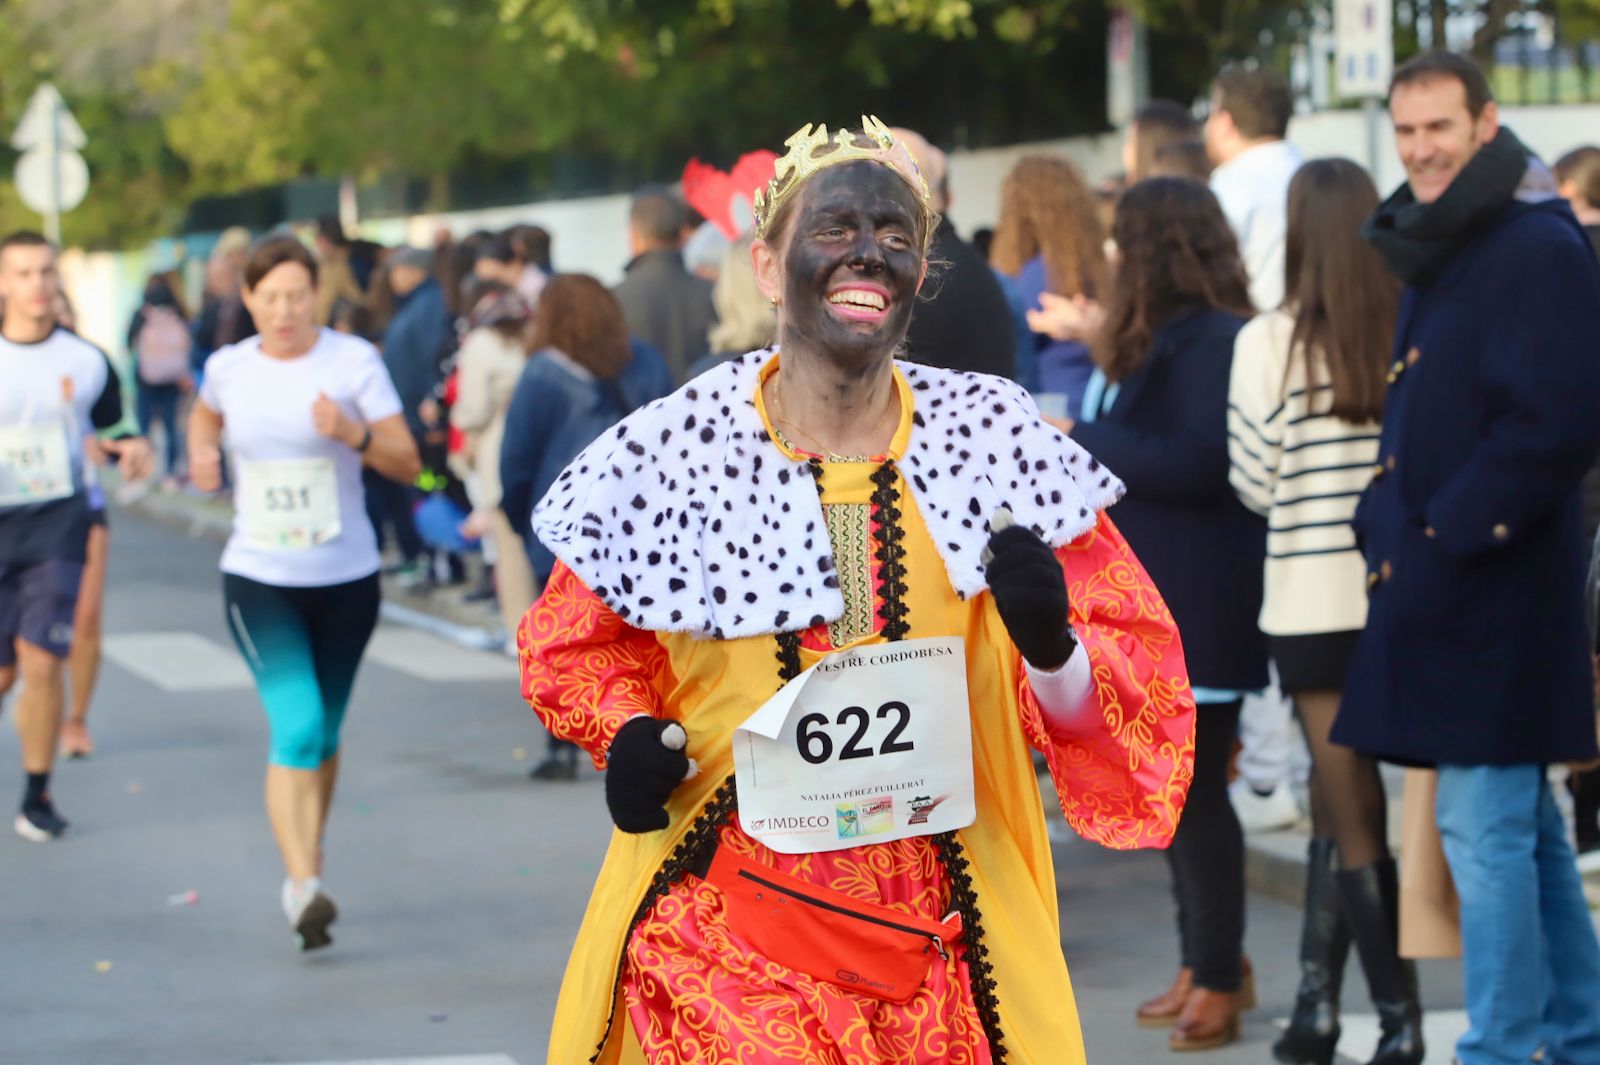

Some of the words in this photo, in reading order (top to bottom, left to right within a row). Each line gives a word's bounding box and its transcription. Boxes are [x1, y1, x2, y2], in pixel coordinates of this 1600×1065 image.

[265, 486, 310, 511] 531
[870, 645, 954, 666] CORDOBESA
[796, 701, 914, 765] 622
[800, 792, 842, 803] NATALIA
[843, 787, 872, 799] PÉREZ
[874, 779, 925, 794] FUILLERAT
[768, 815, 829, 830] IMDECO
